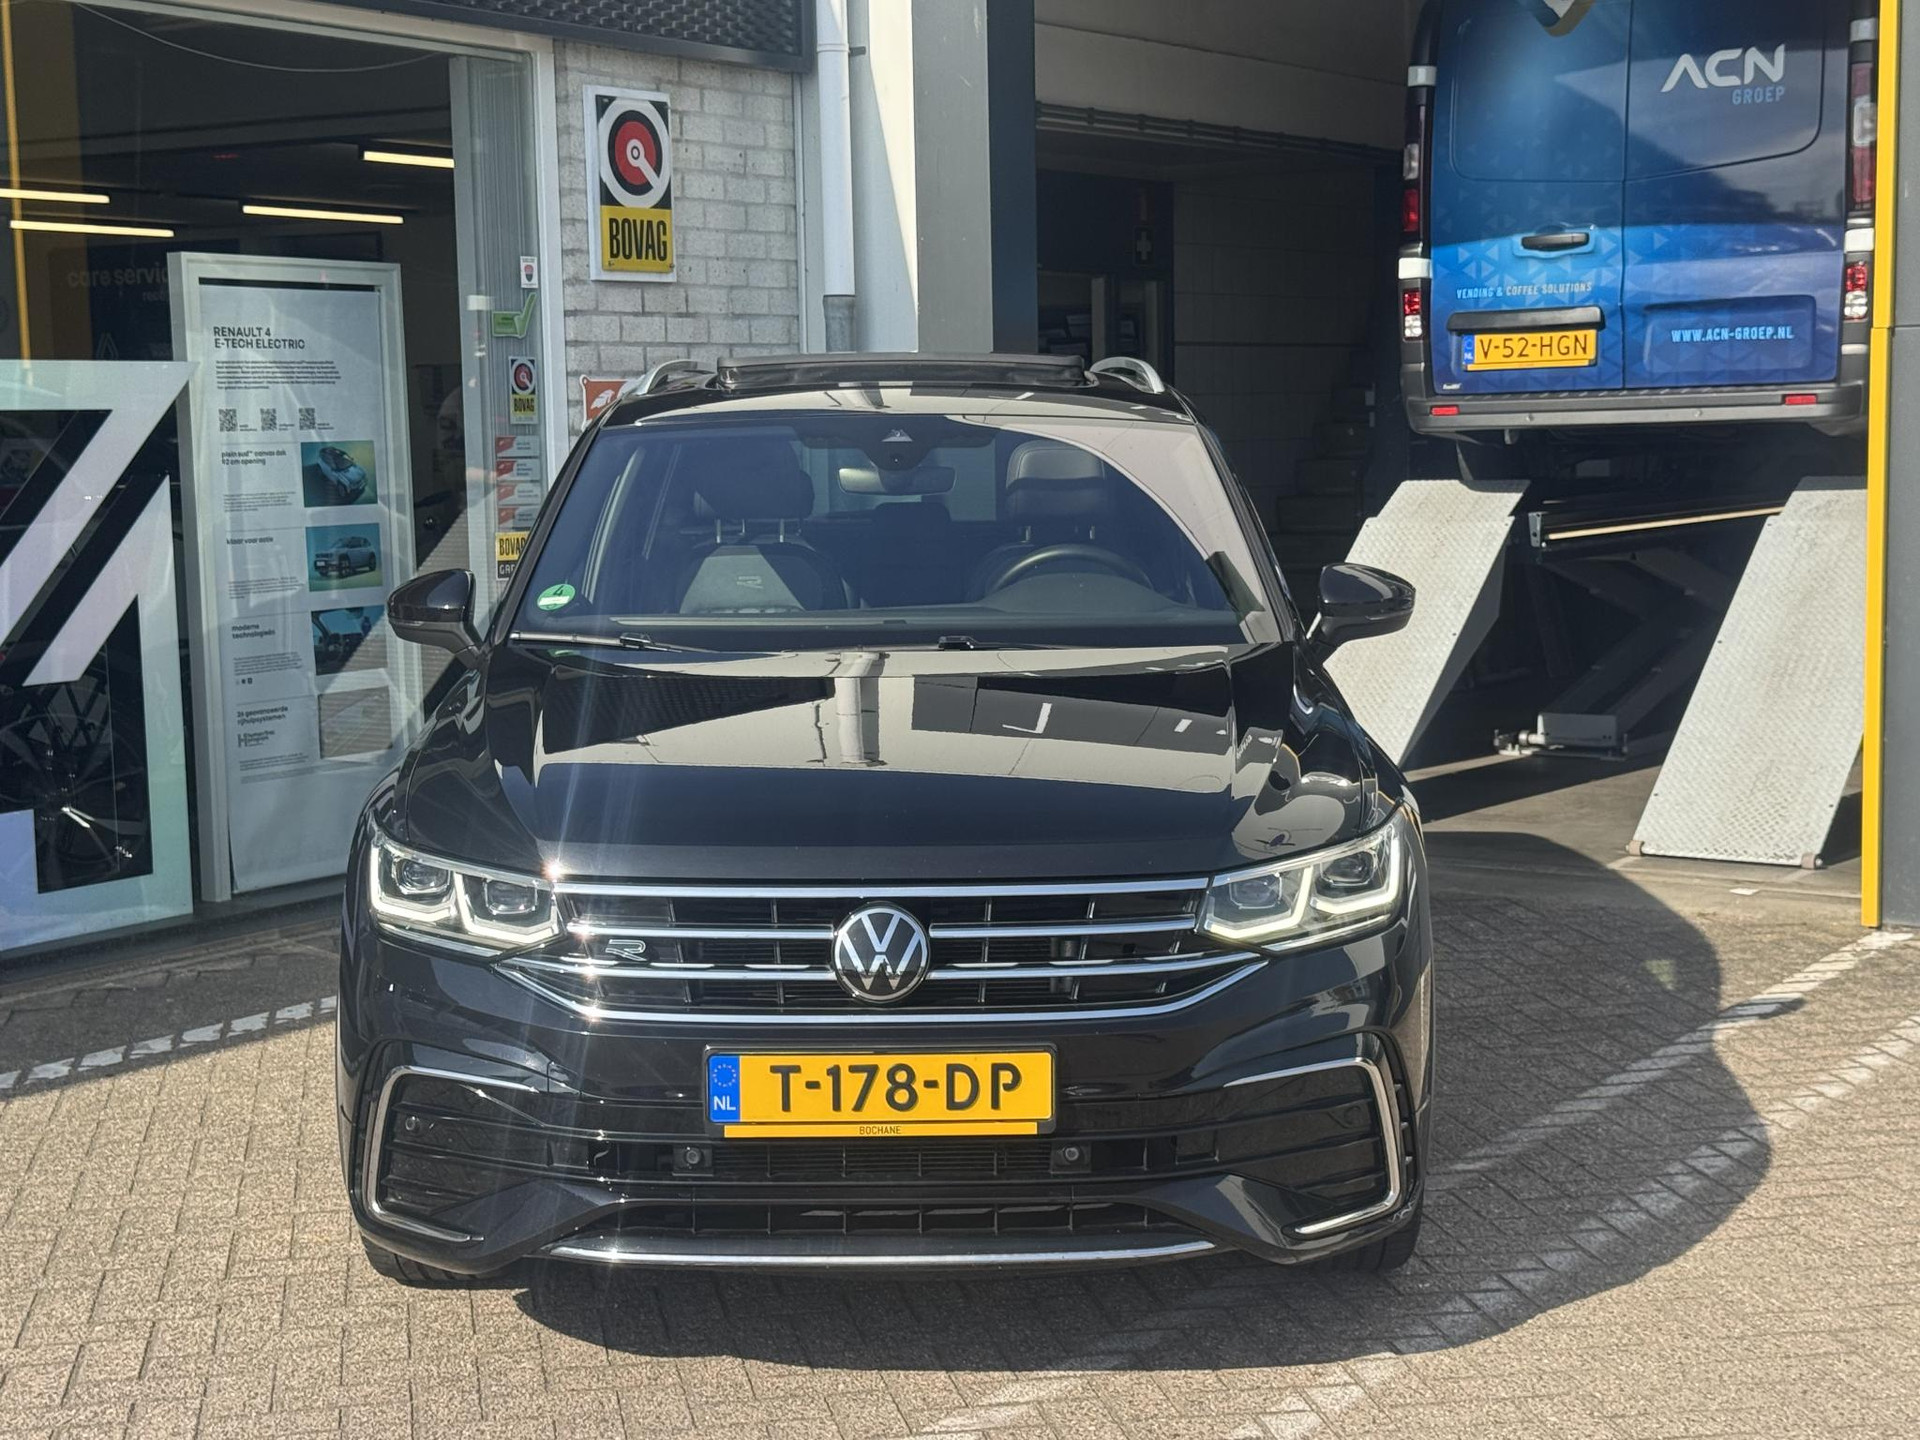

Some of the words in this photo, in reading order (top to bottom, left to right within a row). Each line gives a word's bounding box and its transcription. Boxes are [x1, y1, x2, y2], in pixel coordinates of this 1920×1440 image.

[1660, 43, 1786, 93] ACN
[1732, 85, 1786, 105] GROEP
[608, 217, 667, 262] BOVAG
[1456, 286, 1494, 299] VENDING
[1496, 286, 1503, 297] &
[1506, 284, 1539, 296] COFFEE
[1541, 282, 1592, 295] SOLUTIONS
[213, 326, 263, 338] RENAULT
[265, 327, 271, 337] 4
[1671, 325, 1794, 342] WWW.ACN-GROEP.NL
[214, 338, 254, 349] E-TECH
[255, 339, 305, 349] ELECTRIC
[1479, 334, 1588, 360] V-52-HGN
[513, 397, 535, 413] BOVAG
[769, 1062, 1023, 1113] T-178-DP
[713, 1095, 736, 1111] NL
[858, 1125, 901, 1135] BOCHANE
